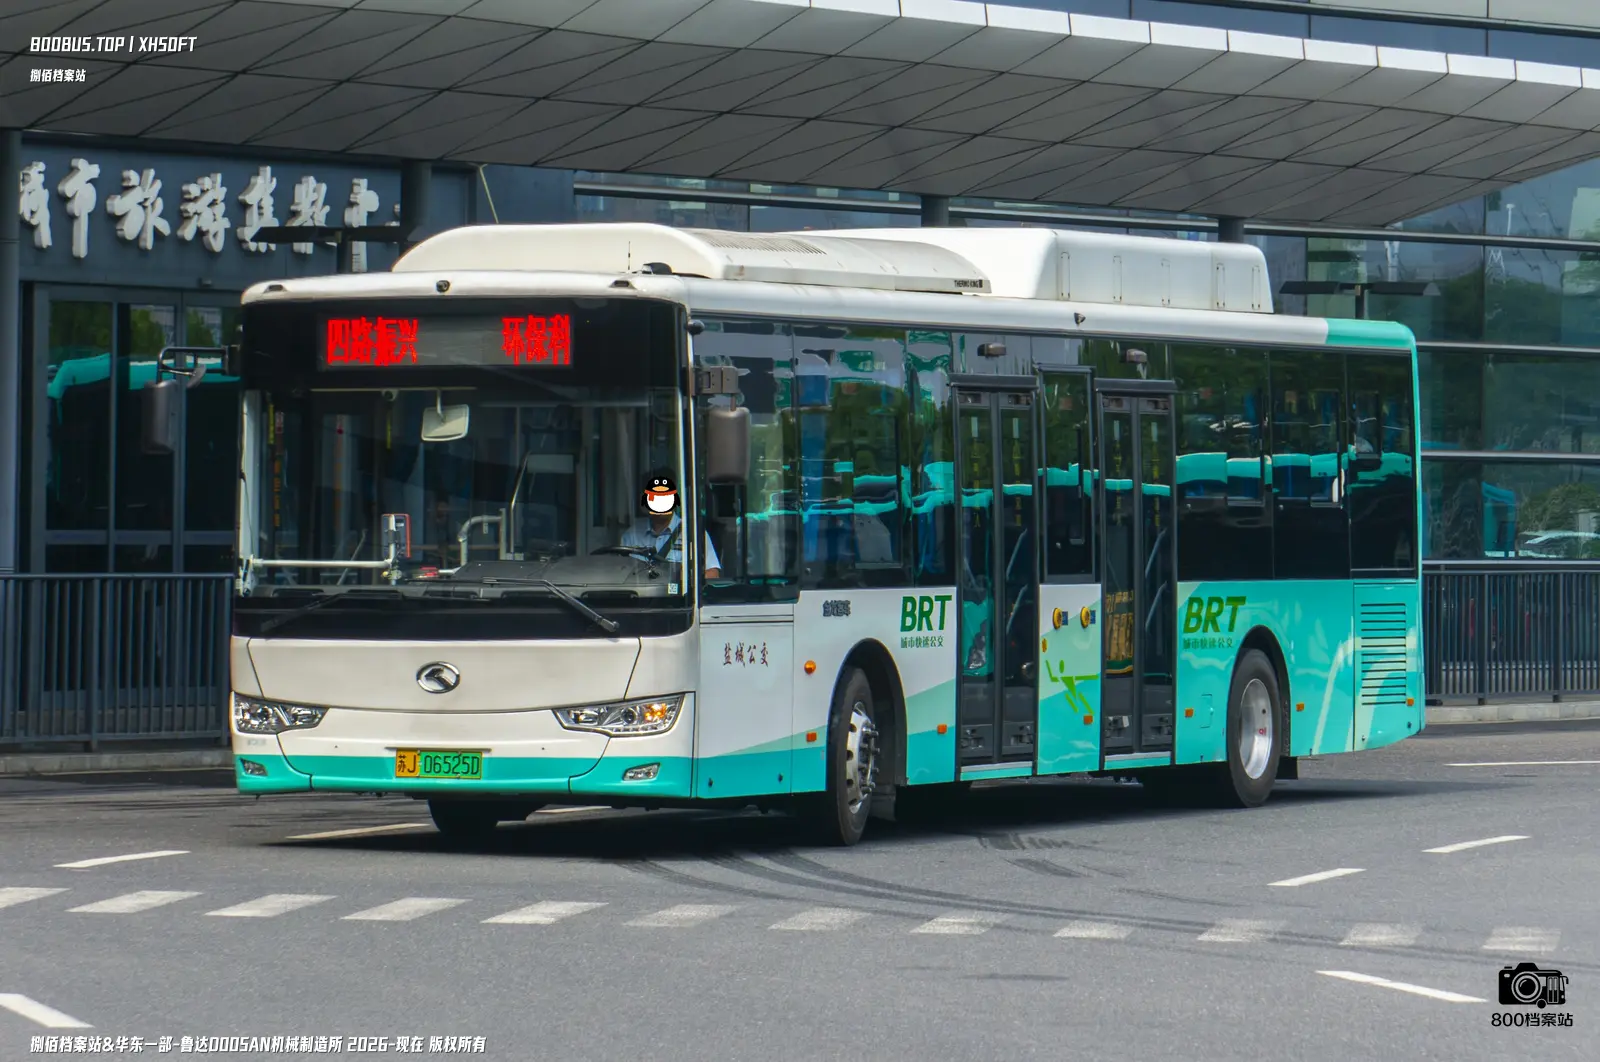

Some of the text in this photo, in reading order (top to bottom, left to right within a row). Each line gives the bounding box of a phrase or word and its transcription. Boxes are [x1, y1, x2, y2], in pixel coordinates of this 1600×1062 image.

[502, 314, 571, 366] 环保科
[900, 595, 953, 632] BRT
[1183, 596, 1247, 633] BRT
[723, 641, 769, 668] 盐城公交
[900, 635, 944, 649] 城市快速公交
